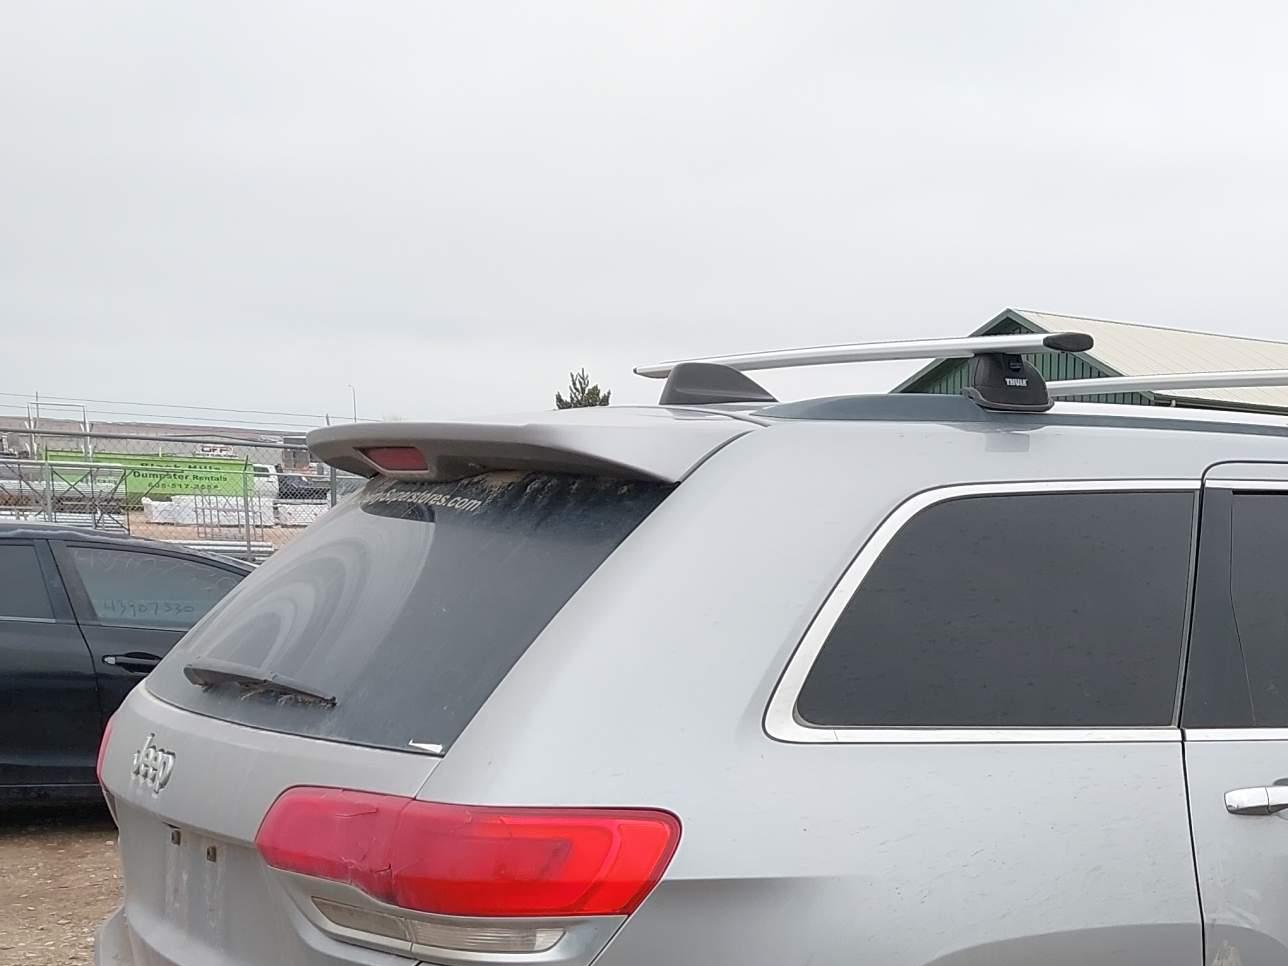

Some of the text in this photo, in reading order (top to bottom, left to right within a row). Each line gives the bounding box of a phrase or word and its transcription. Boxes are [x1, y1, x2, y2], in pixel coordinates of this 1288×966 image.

[133, 470, 227, 482] Dumpster Rentals
[132, 733, 175, 793] Jeep
